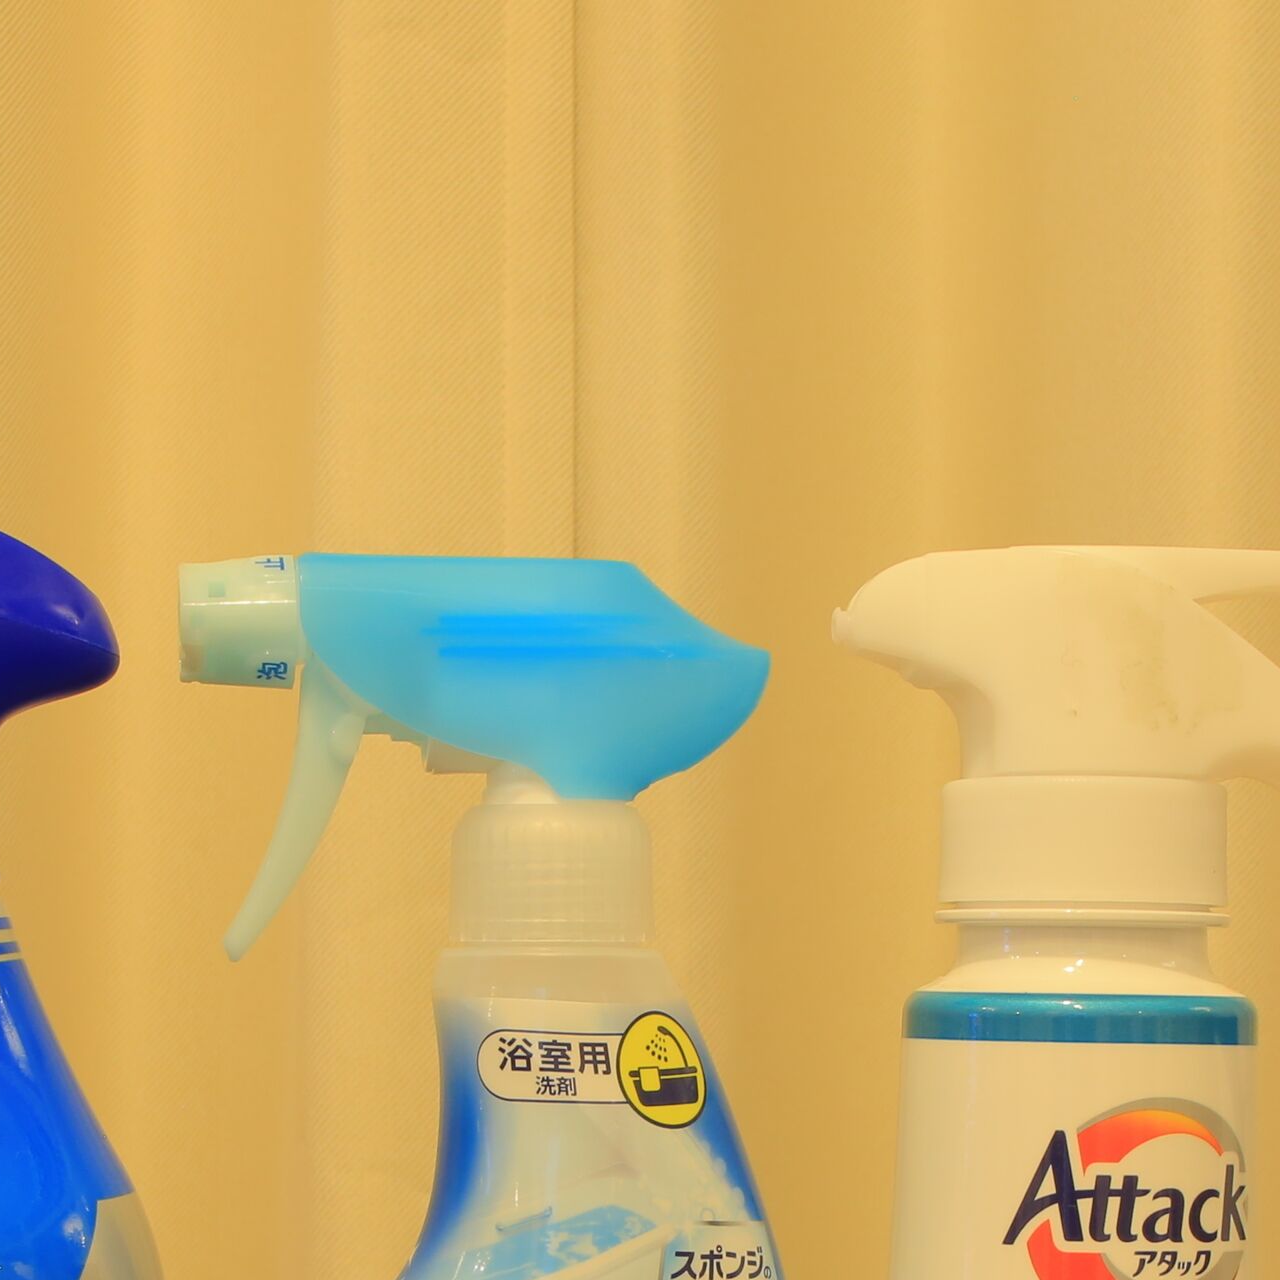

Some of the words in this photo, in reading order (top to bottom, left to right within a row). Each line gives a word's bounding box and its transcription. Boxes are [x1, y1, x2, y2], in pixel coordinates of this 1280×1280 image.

[257, 662, 288, 680] 泡
[497, 1036, 612, 1075] 浴室用
[535, 1075, 577, 1096] 洗剤
[1002, 1130, 1247, 1245] Attack
[670, 1246, 772, 1280] スポンジの
[1133, 1250, 1212, 1278] アタック
